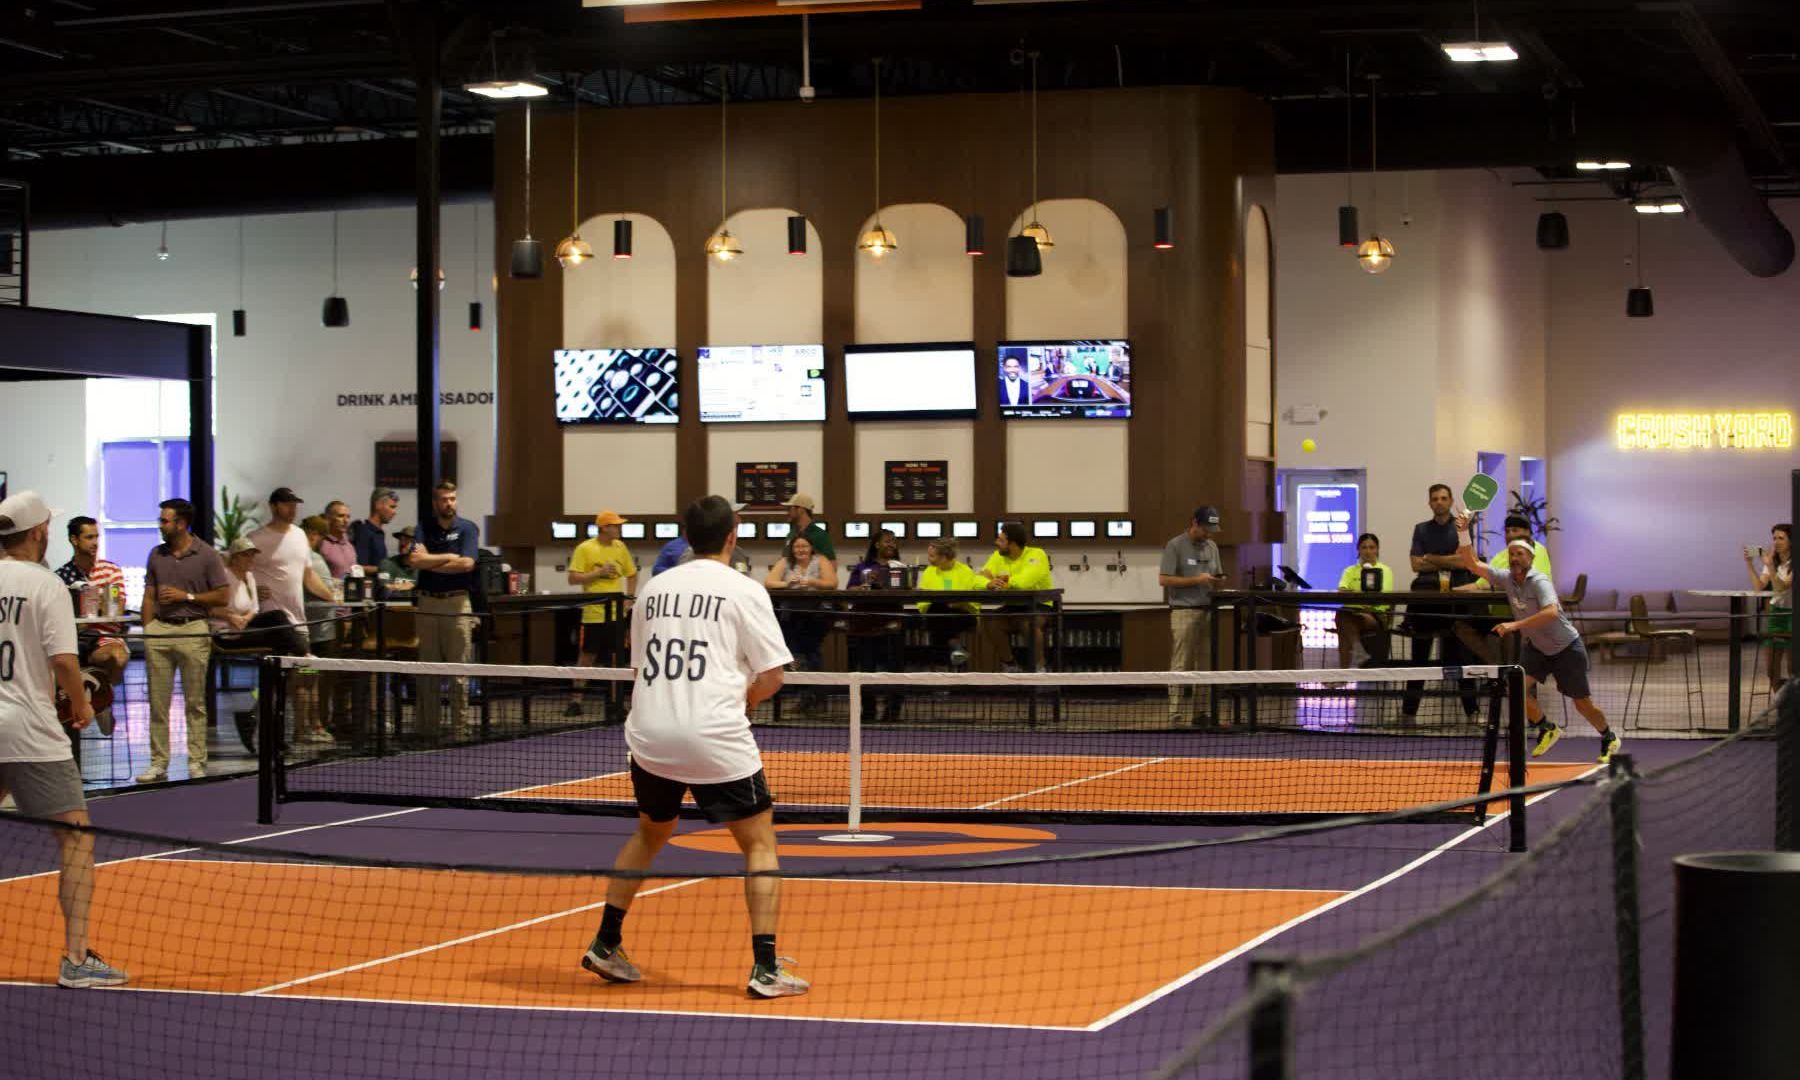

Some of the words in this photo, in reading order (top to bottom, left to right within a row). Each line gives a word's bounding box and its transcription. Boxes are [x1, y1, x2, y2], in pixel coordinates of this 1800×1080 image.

[337, 394, 385, 407] DRINK
[389, 392, 494, 406] AMSADO
[1617, 413, 1712, 449] CRUSH
[1714, 412, 1792, 448] YARD
[0, 596, 28, 625] SIT
[646, 593, 682, 621] BILL
[689, 594, 726, 621] DIT
[643, 633, 708, 686] $65
